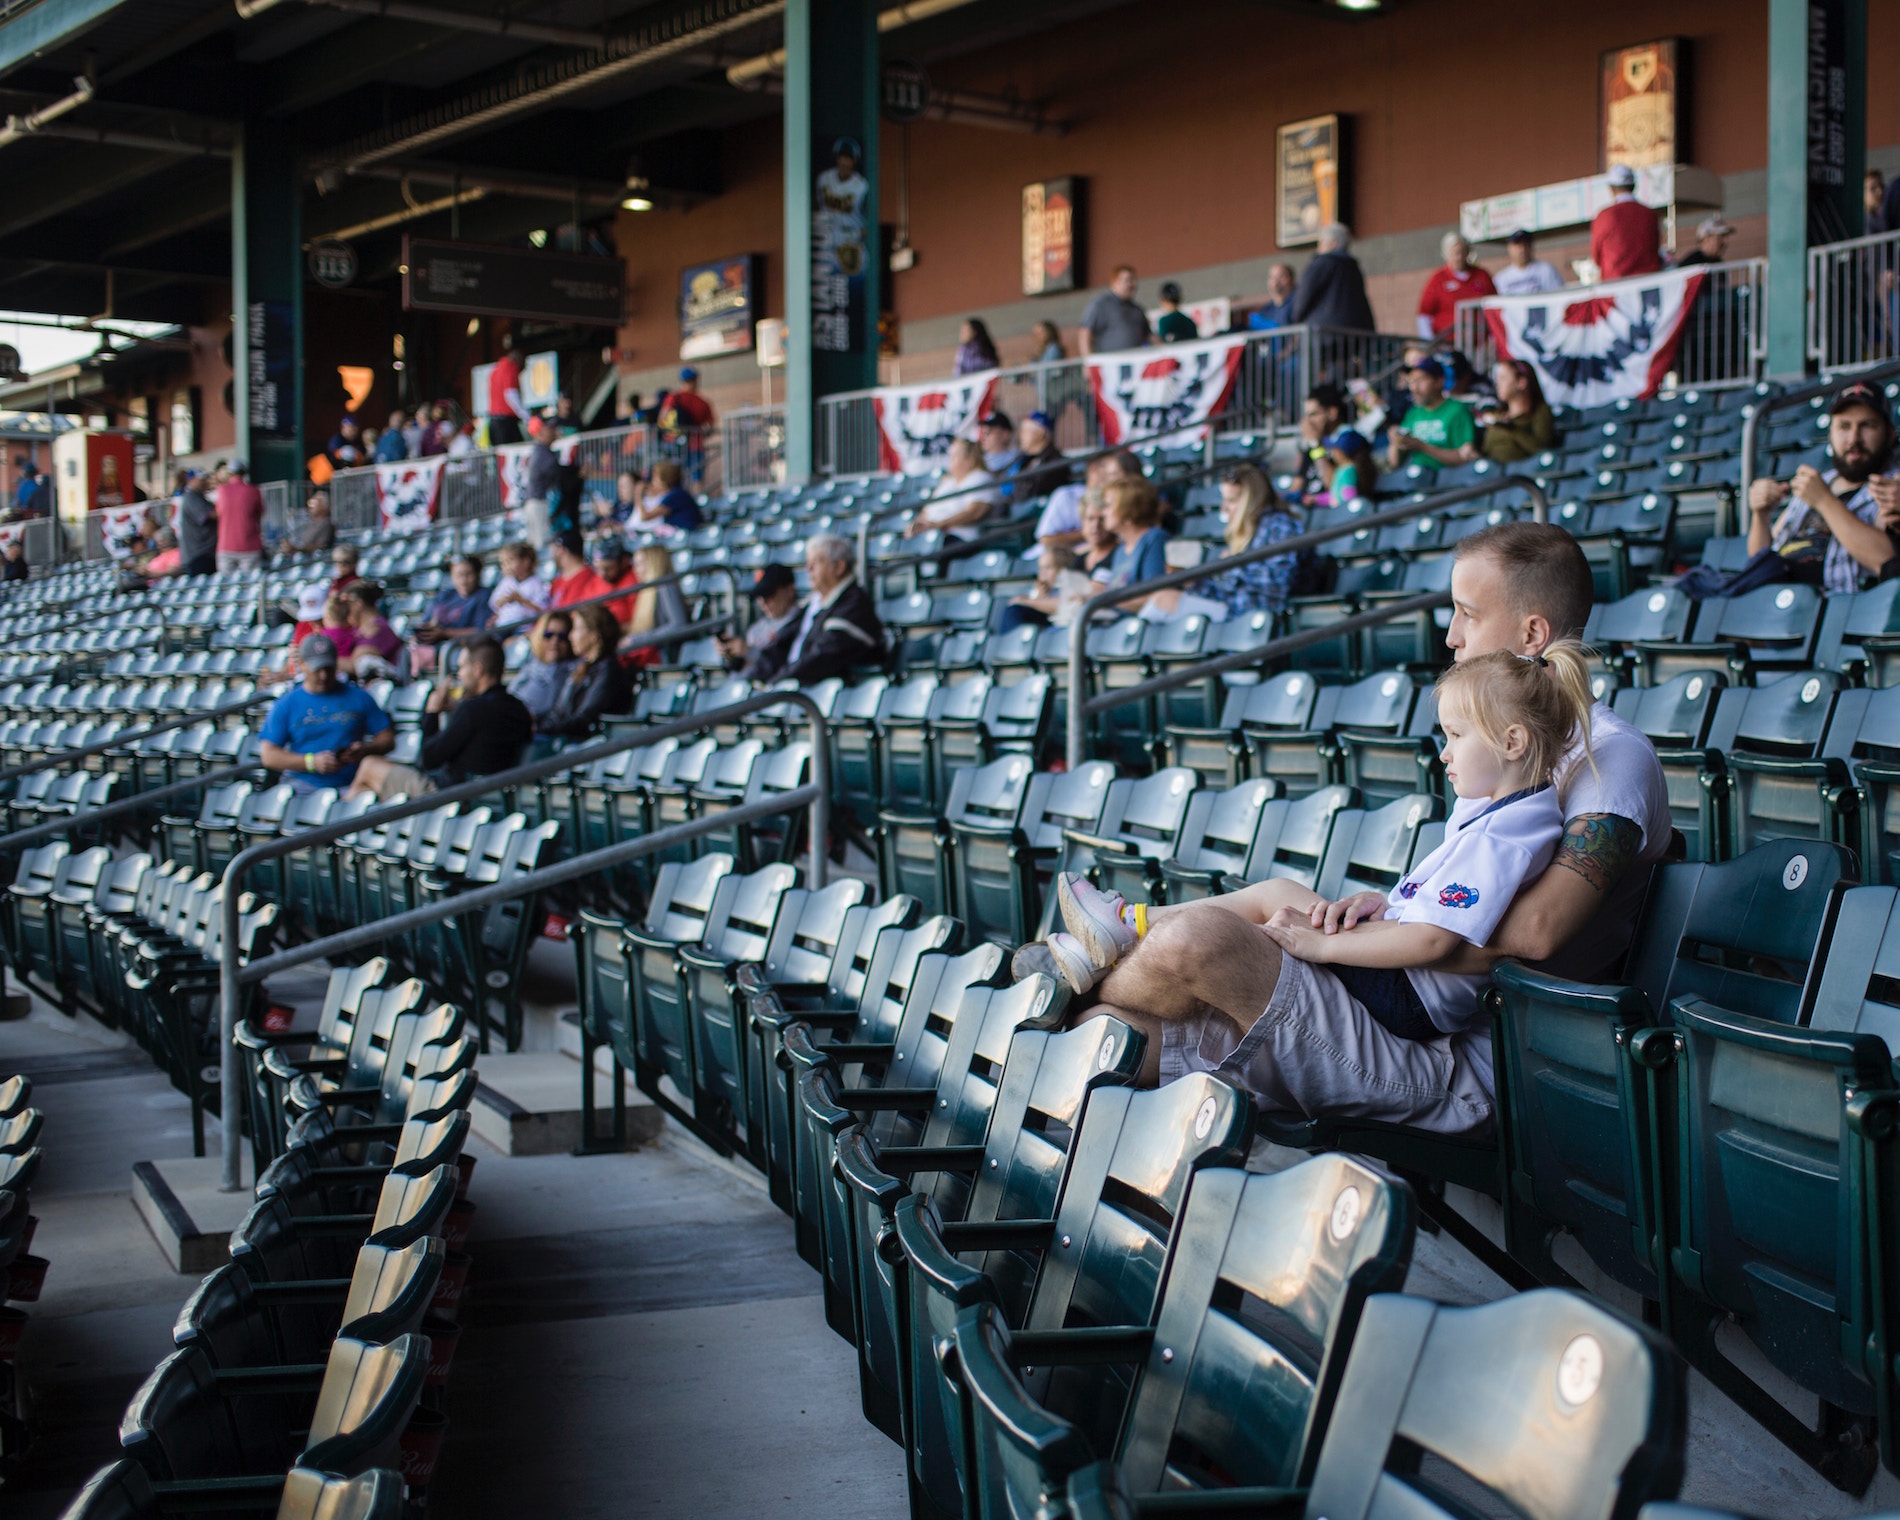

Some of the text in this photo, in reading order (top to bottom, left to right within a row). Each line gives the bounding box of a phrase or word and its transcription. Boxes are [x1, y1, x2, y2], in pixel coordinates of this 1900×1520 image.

[318, 256, 350, 279] 113
[1789, 863, 1801, 882] 8
[1200, 1107, 1210, 1129] 7
[1338, 1200, 1352, 1227] 6
